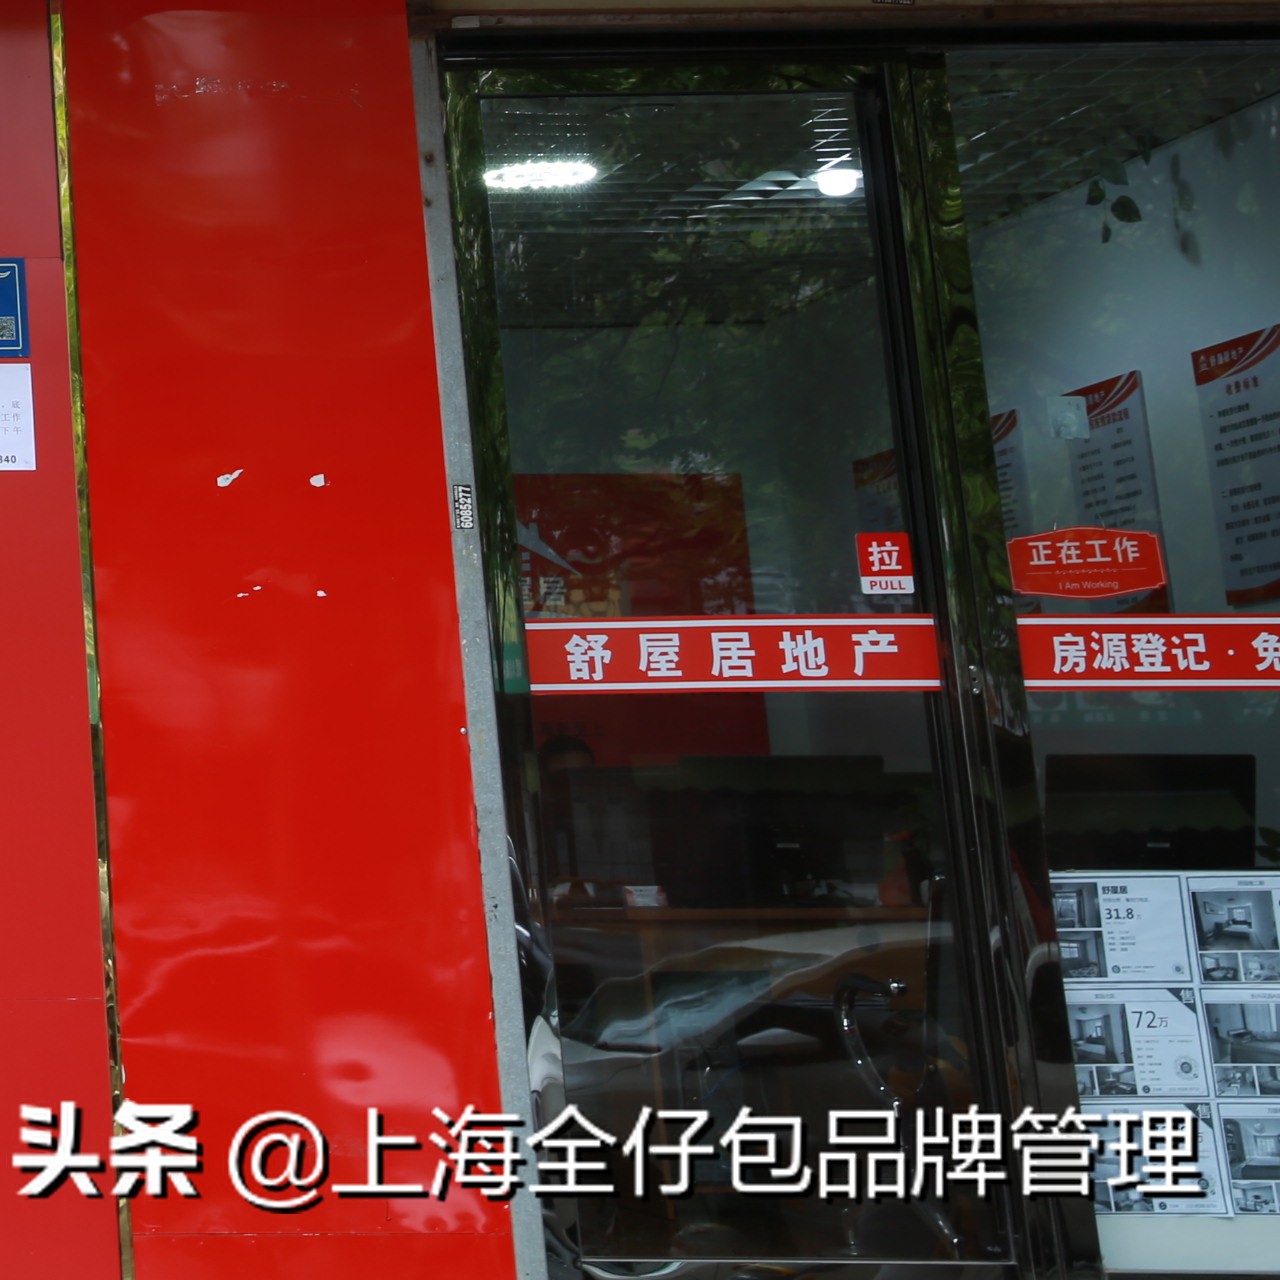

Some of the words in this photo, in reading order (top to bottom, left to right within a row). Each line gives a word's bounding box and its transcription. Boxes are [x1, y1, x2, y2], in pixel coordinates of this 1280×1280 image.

[458, 485, 473, 529] 6085277
[868, 541, 902, 572] 拉
[1027, 535, 1141, 566] 正在工作
[870, 580, 906, 591] PULL
[1065, 582, 1081, 590] Am
[1082, 580, 1119, 590] Working
[564, 627, 899, 682] 舒屋居地产
[1105, 908, 1135, 920] 31.8
[1131, 1010, 1168, 1029] 72万
